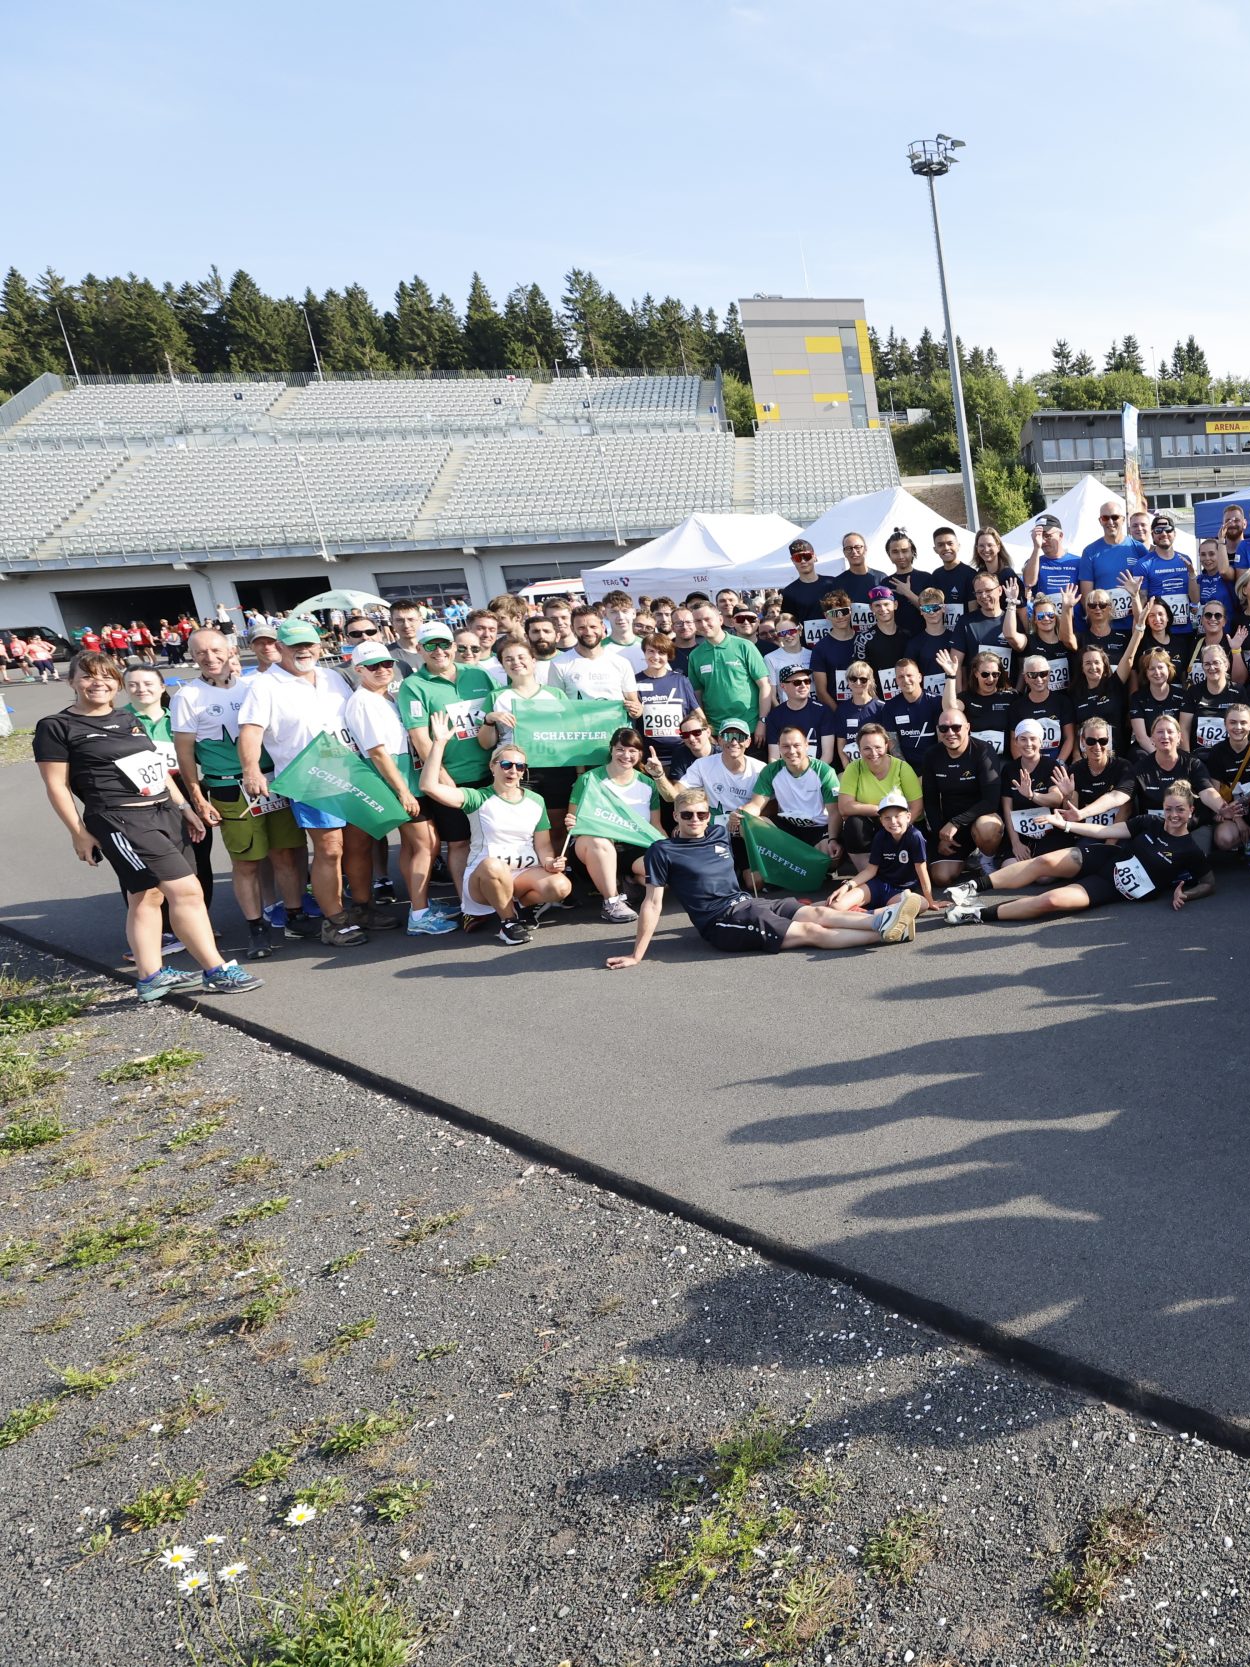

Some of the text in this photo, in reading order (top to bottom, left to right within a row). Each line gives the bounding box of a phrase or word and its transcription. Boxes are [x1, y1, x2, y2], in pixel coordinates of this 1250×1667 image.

[603, 579, 620, 587] TEAG
[853, 612, 877, 625] 446
[806, 628, 834, 642] 446
[645, 714, 680, 729] 2968
[533, 731, 607, 742] SCHAEFFLER
[137, 762, 164, 786] 837
[307, 765, 385, 815] SCHAEFFLER
[1092, 812, 1116, 827] 861
[756, 845, 808, 877] HAEFFLER
[1118, 866, 1141, 893] 851
